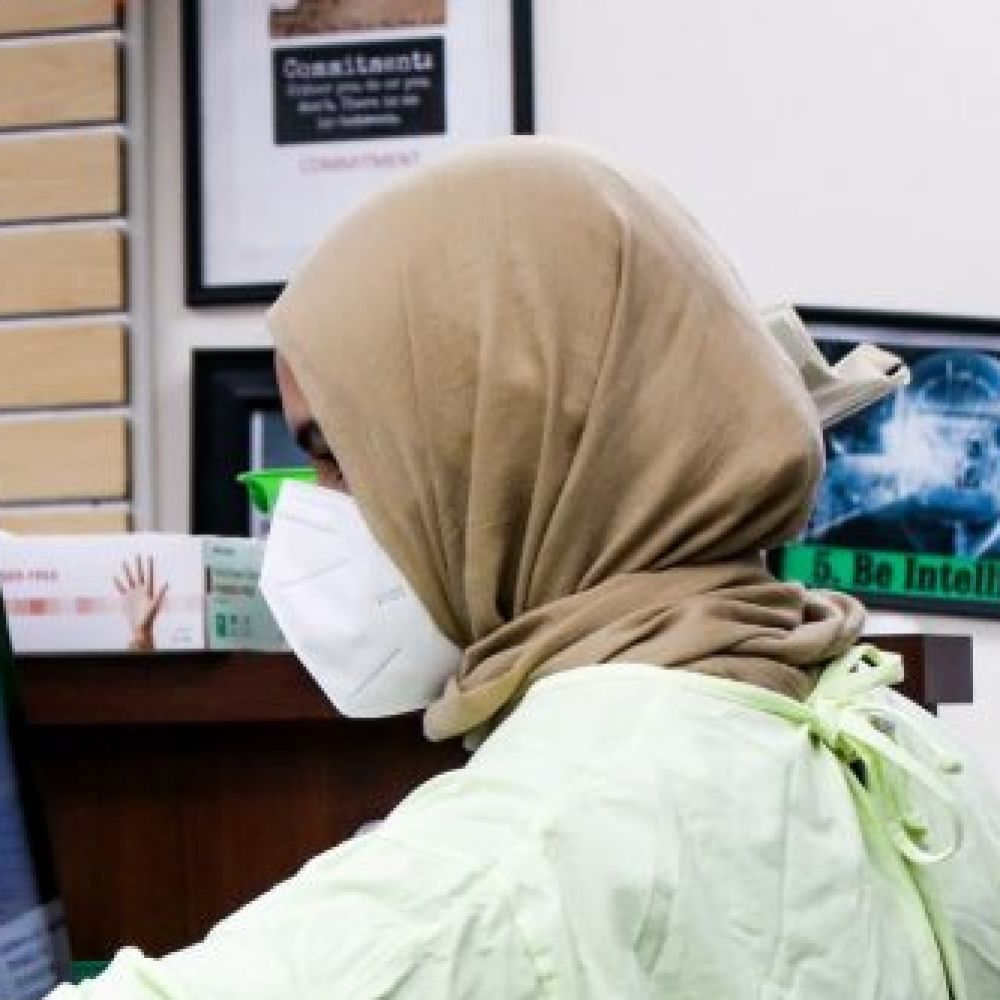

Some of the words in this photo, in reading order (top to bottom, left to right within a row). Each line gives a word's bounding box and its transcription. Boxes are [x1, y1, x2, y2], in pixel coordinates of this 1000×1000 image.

[282, 51, 434, 79] Commitments
[299, 151, 420, 173] COMMITMENT
[812, 551, 842, 589] 5.
[855, 551, 893, 588] Be
